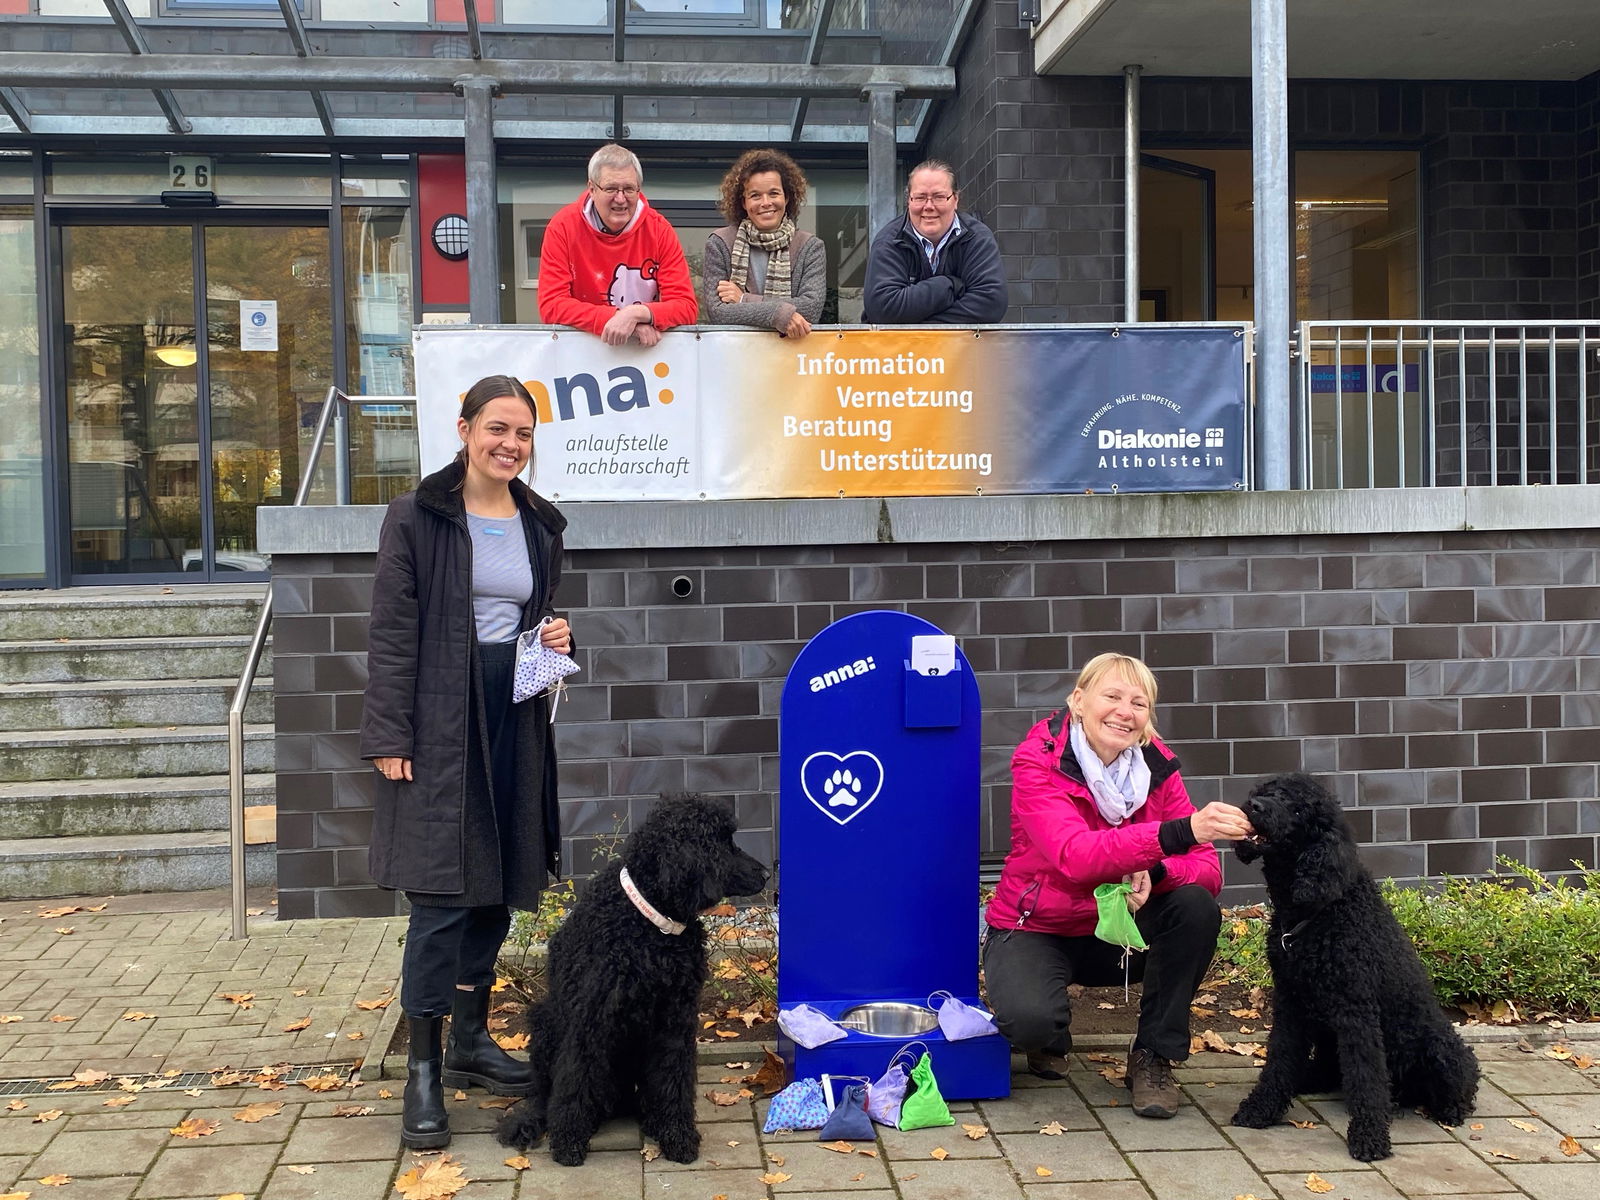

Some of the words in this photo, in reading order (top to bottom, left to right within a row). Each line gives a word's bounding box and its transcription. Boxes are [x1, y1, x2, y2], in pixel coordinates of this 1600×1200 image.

[173, 165, 208, 188] 26
[797, 351, 945, 376] Information
[459, 361, 675, 424] nna:
[836, 385, 974, 413] Vernetzung
[1081, 402, 1115, 438] ERFAHRUNG.
[1115, 393, 1139, 406] NÄHE.
[1141, 392, 1183, 414] KOMPETENZ.
[783, 415, 893, 442] Beratung
[1098, 427, 1202, 450] Diakonie
[566, 433, 669, 455] anlaufstelle
[566, 456, 691, 478] nachbarschaft
[820, 448, 993, 475] Unterstützung
[1098, 453, 1224, 469] Altholstein
[809, 655, 877, 693] anna:
